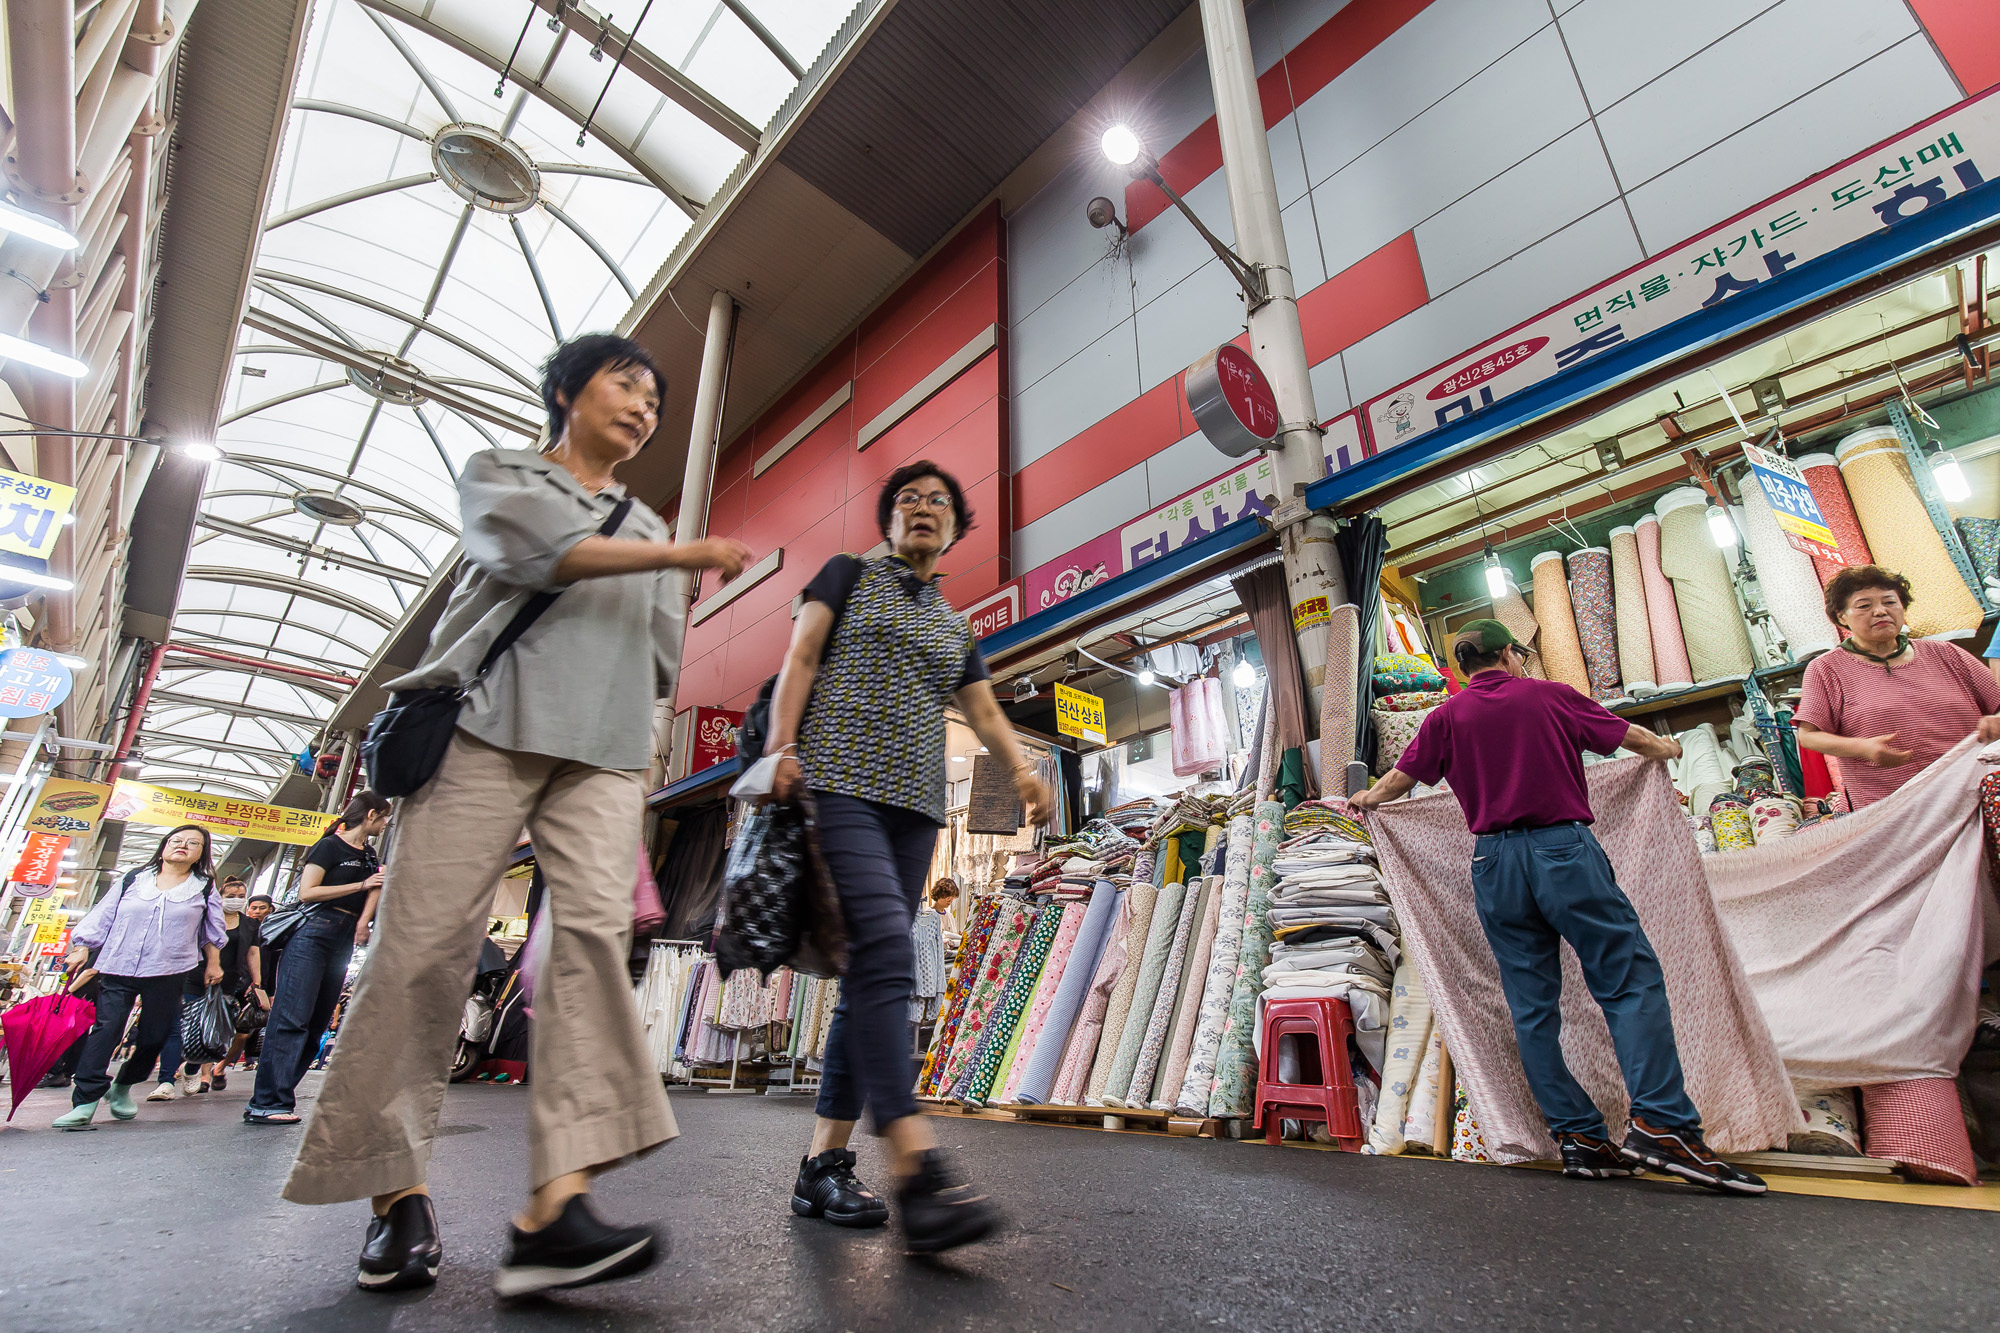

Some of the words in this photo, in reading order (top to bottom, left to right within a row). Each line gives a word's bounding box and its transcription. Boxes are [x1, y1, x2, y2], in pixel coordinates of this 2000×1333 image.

[1443, 344, 1532, 394] 광신2동45호
[1202, 472, 1248, 507] 면직물
[1758, 473, 1824, 524] 민중상회
[972, 606, 1009, 637] 화이트
[12, 651, 51, 671] 원조
[1057, 698, 1104, 729] 덕산상회
[152, 791, 219, 812] 온누리상품권
[224, 801, 282, 824] 부정유통
[285, 811, 322, 829] 근절!!
